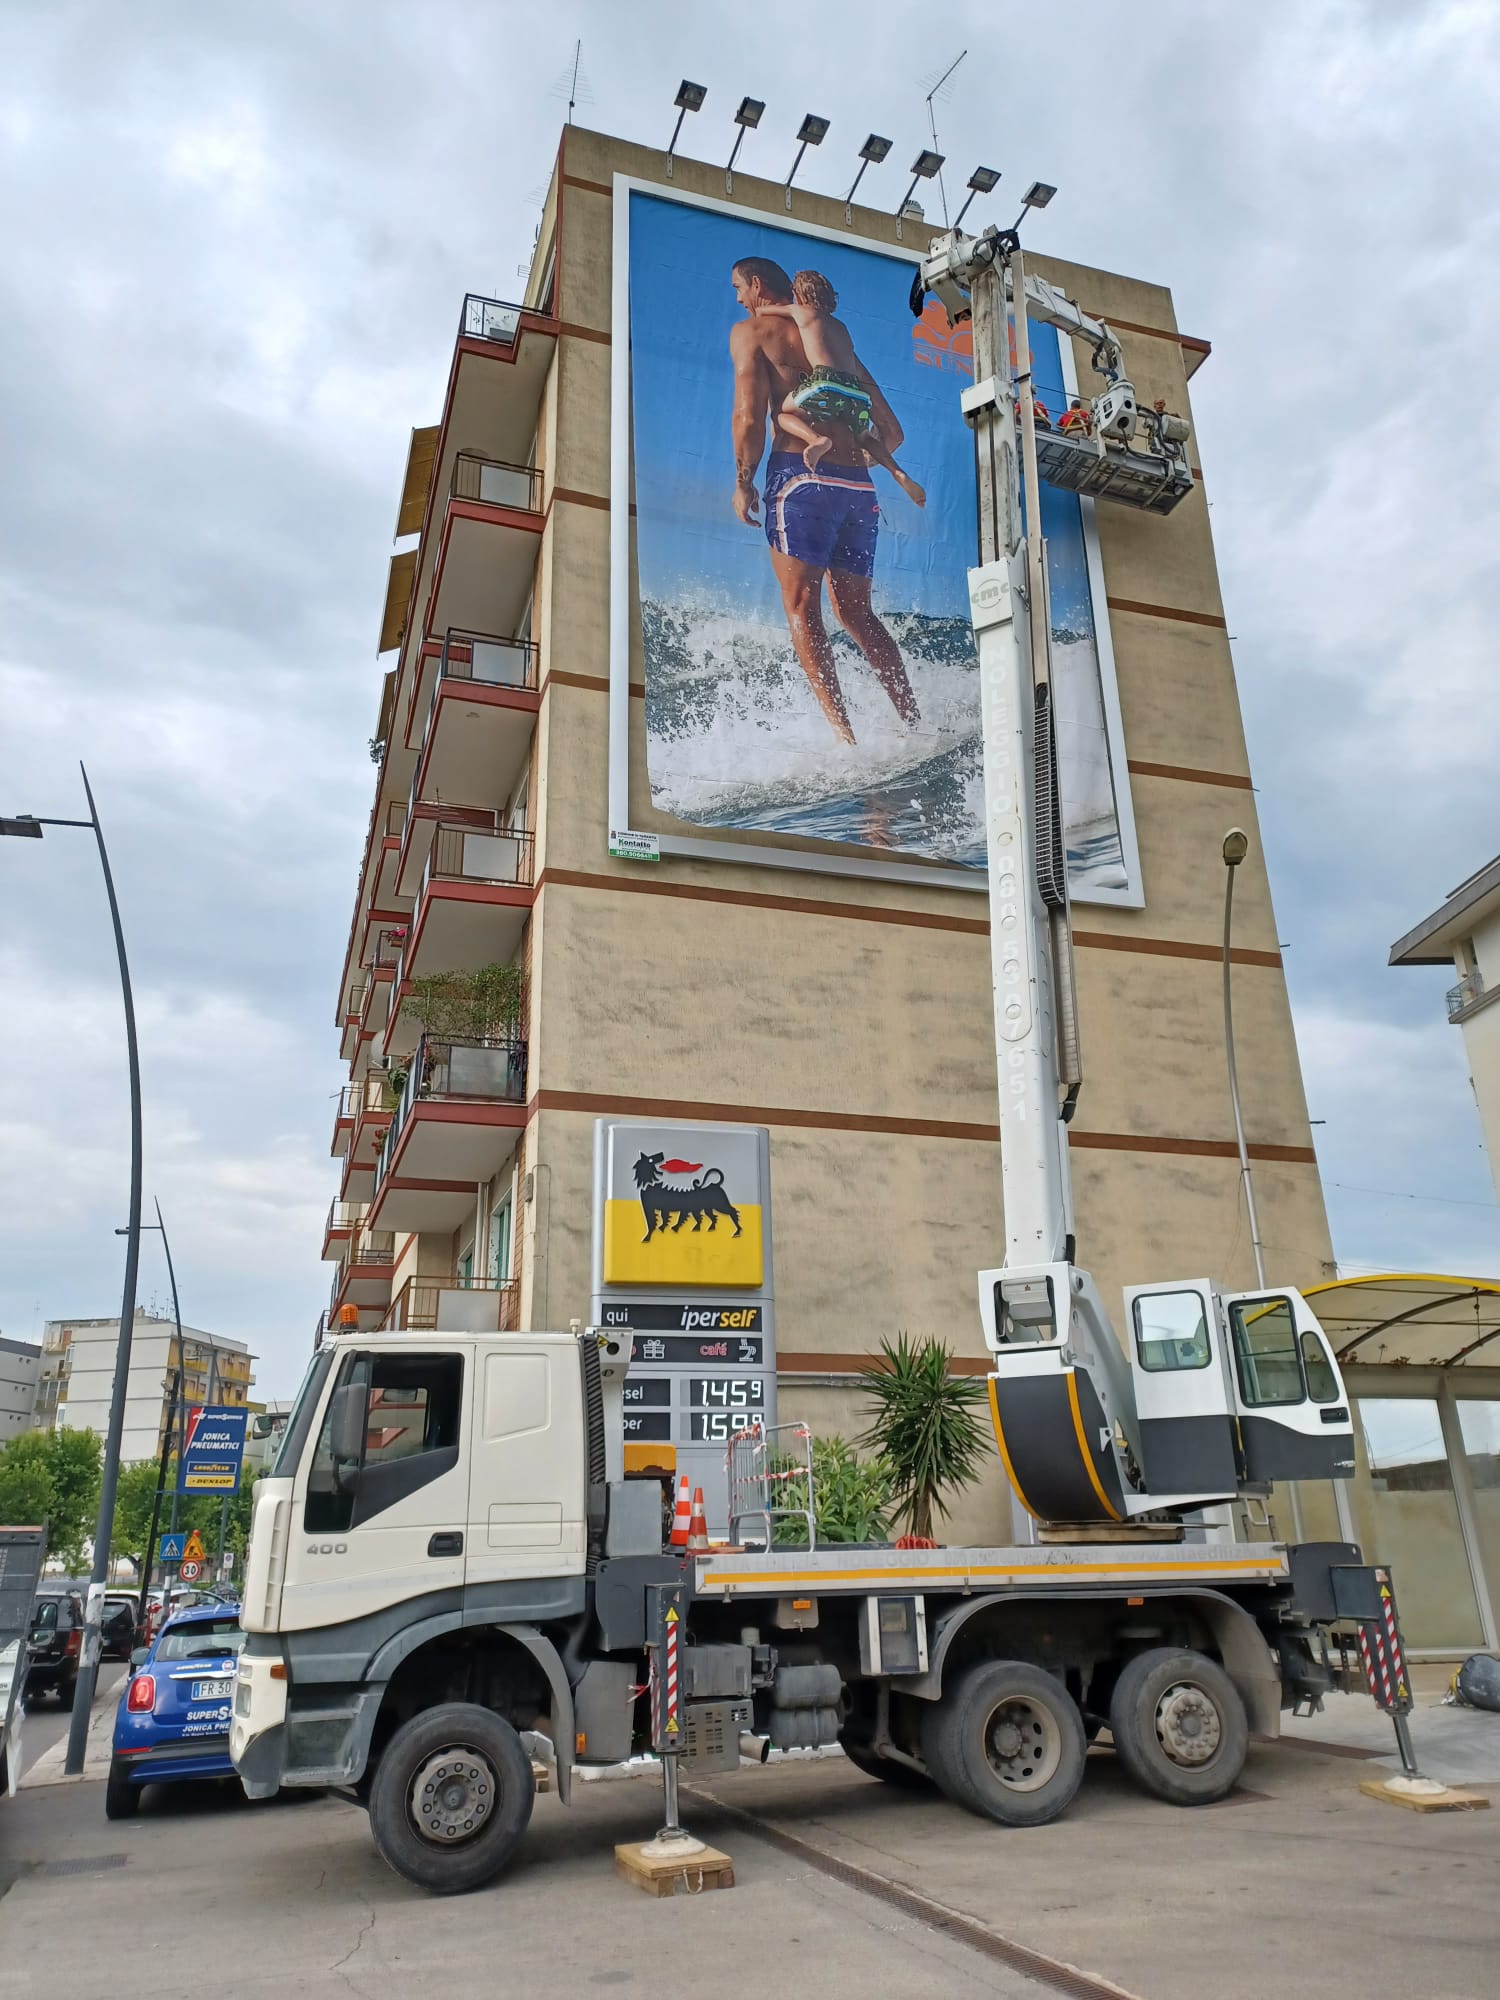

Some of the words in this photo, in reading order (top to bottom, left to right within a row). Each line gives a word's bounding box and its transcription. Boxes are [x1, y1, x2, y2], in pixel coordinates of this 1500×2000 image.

[914, 350, 975, 377] SUN
[971, 582, 1009, 604] cmc
[618, 838, 651, 848] Kontatto
[606, 1308, 628, 1325] qui
[680, 1306, 757, 1331] iperself
[700, 1342, 728, 1356] café
[624, 1386, 643, 1400] sel
[201, 1432, 230, 1441] JONICA
[190, 1441, 240, 1450] PNEUMATICI
[306, 1543, 348, 1555] 400
[185, 1565, 196, 1575] 30
[201, 1684, 214, 1695] FR
[218, 1682, 231, 1693] 30
[186, 1706, 232, 1721] SUPERSE
[182, 1724, 212, 1732] JONICA
